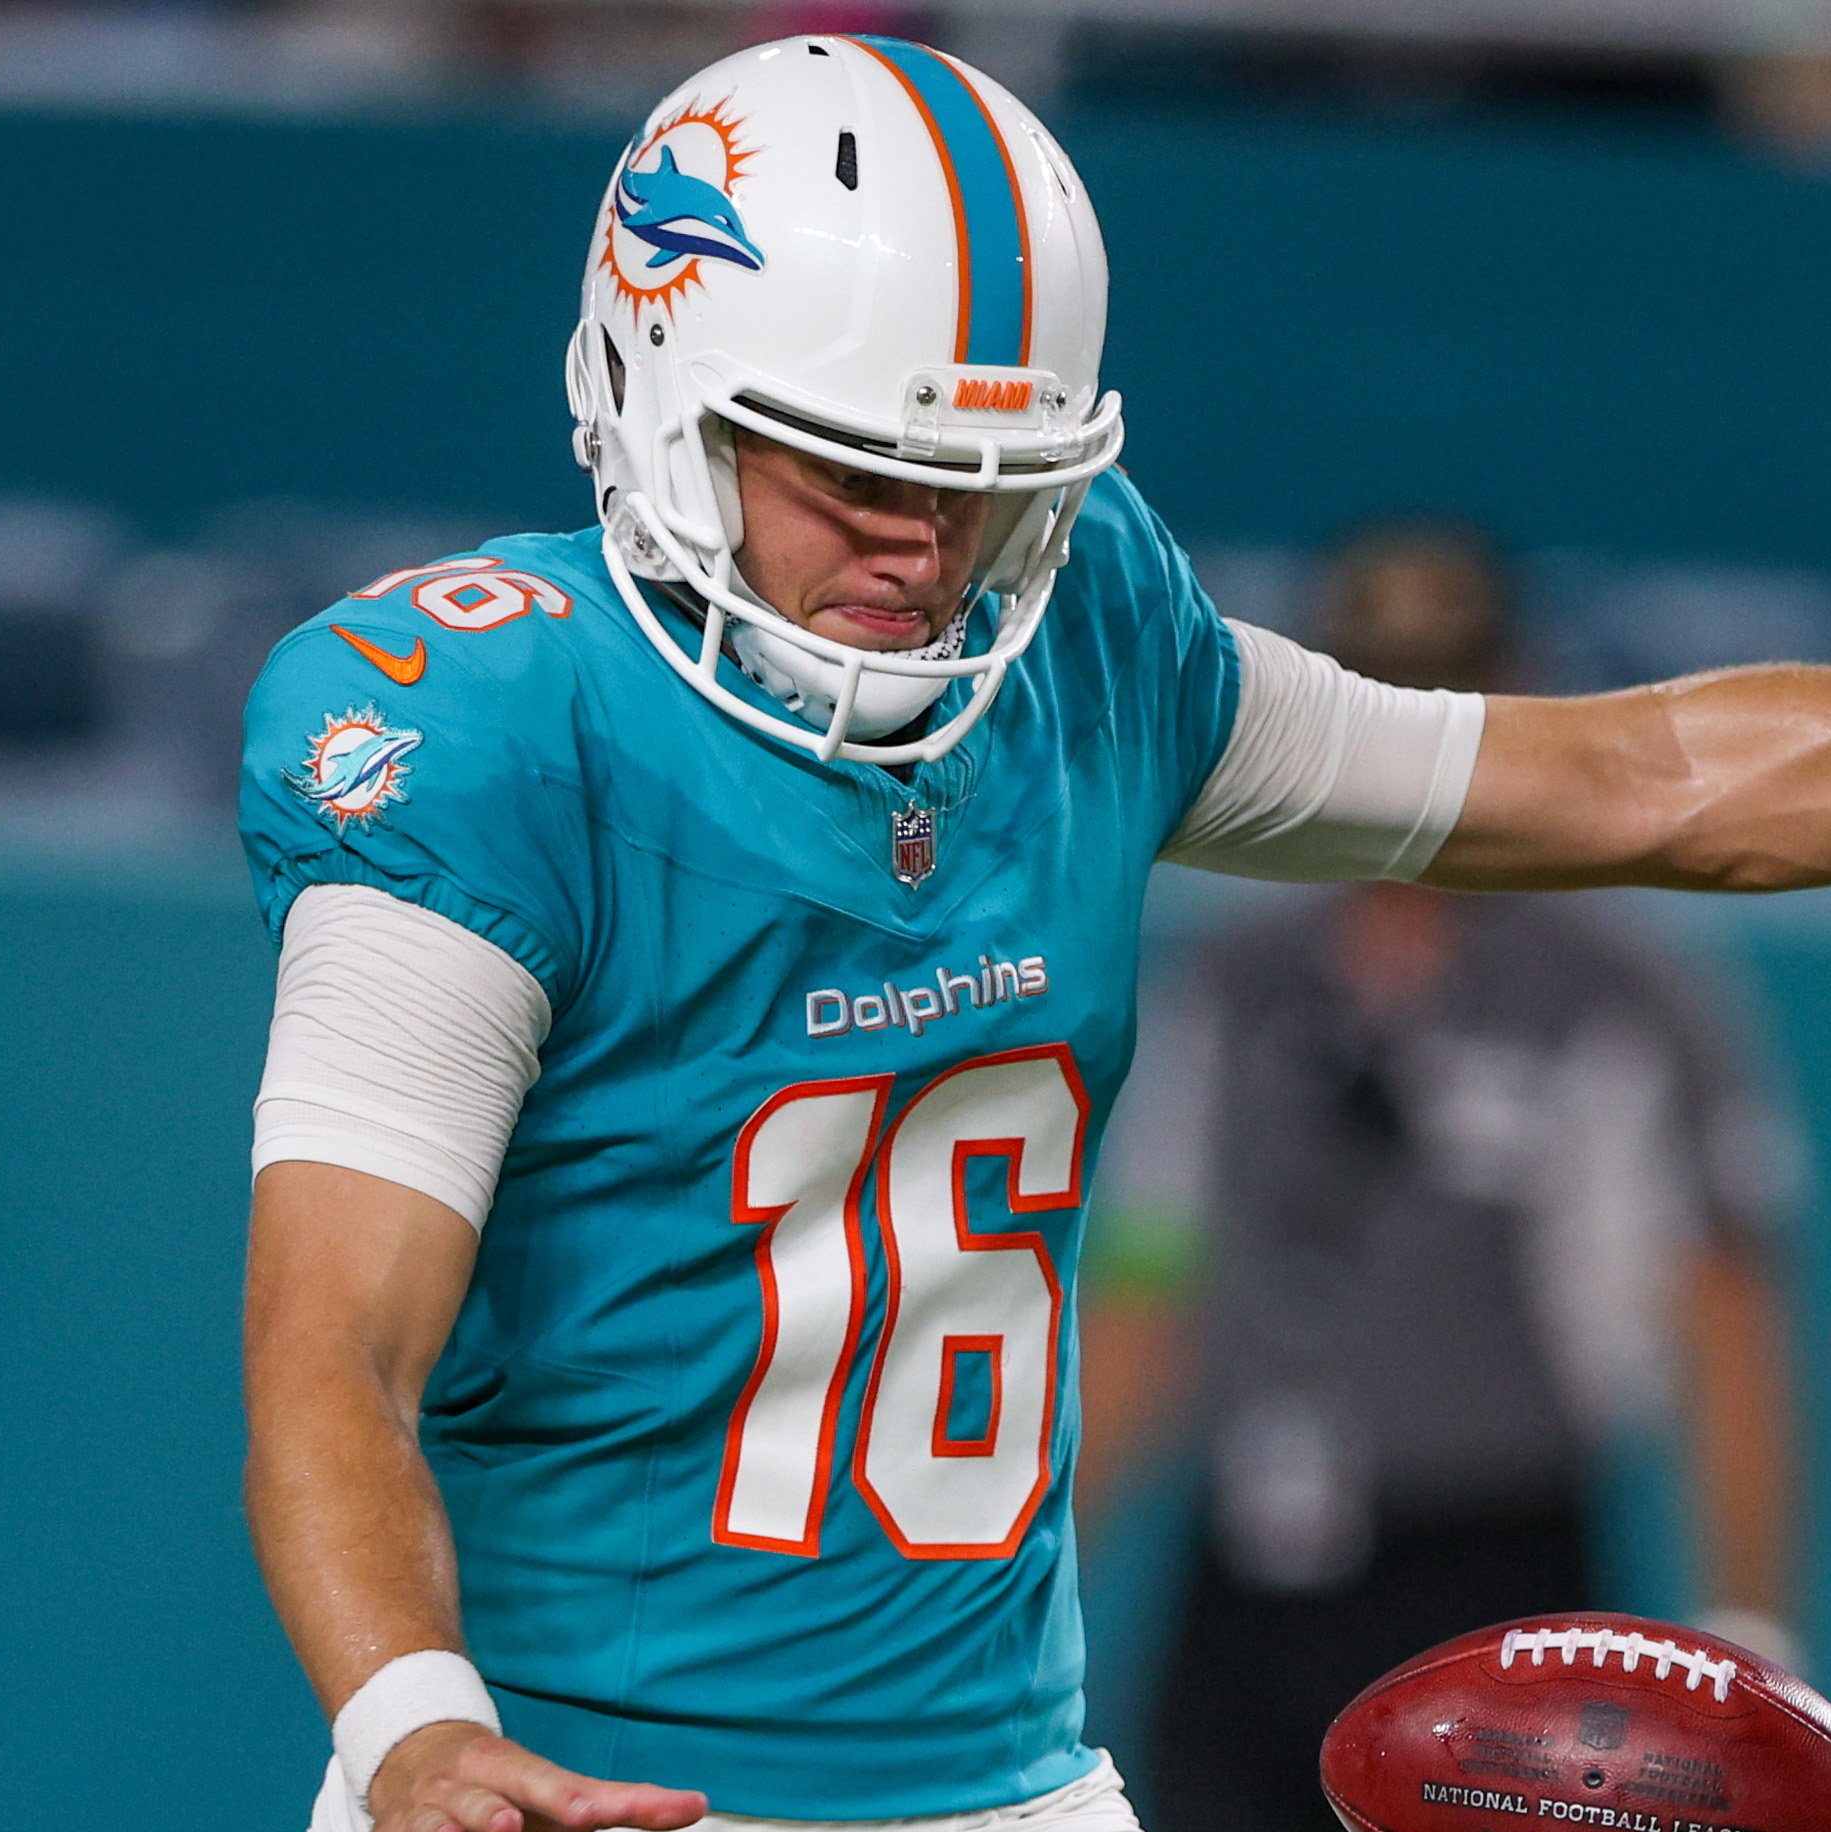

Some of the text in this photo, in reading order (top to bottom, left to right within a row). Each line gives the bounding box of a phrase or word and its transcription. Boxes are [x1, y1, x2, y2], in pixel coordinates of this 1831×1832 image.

[952, 378, 1034, 411] MIAMI
[352, 556, 574, 633] 16
[899, 841, 931, 873] NFL
[806, 954, 1049, 1038] Dolphins
[712, 1042, 1091, 1560] 16
[1422, 1783, 1529, 1815] NATIONAL
